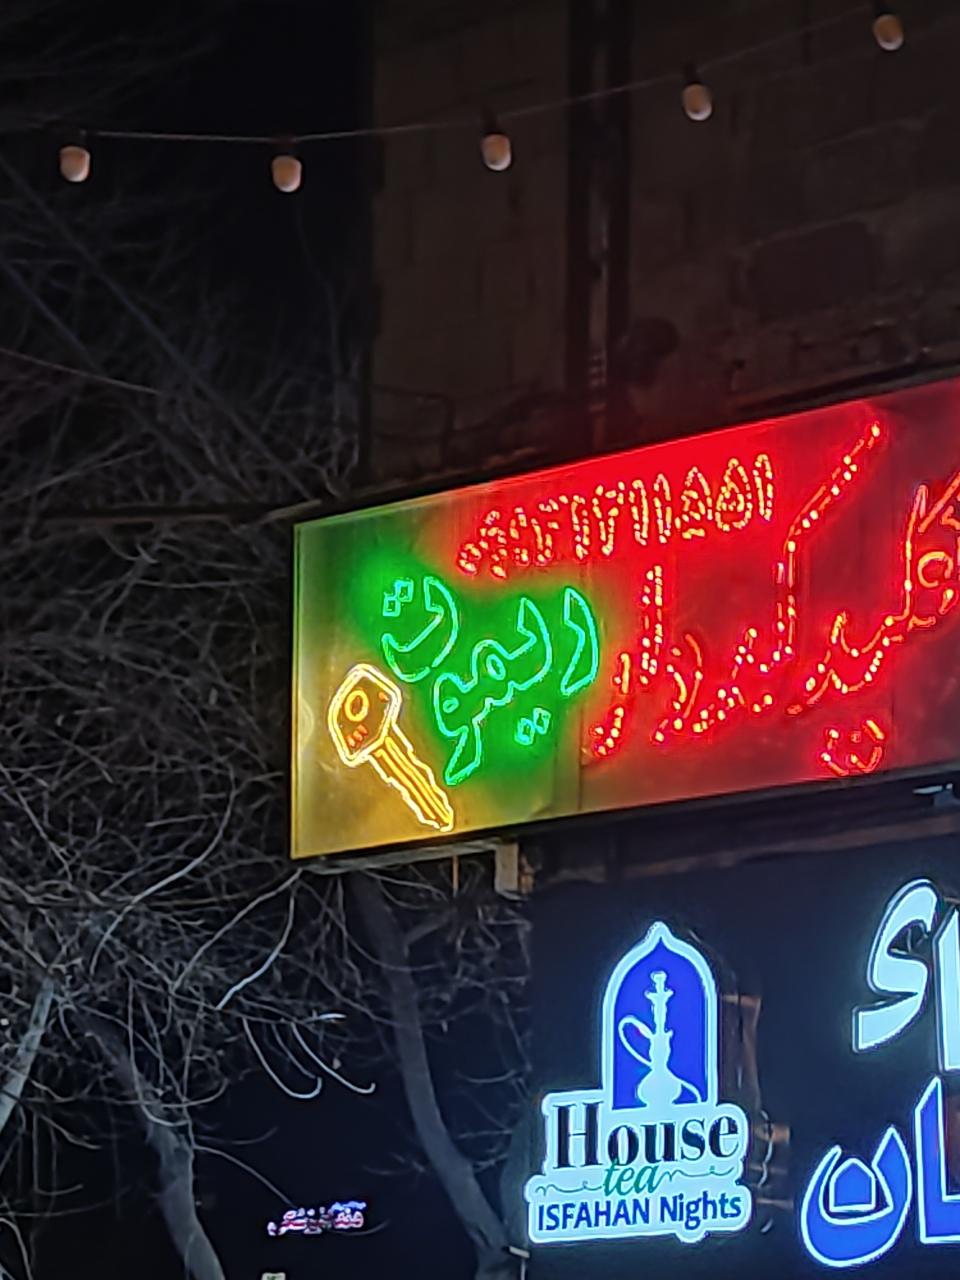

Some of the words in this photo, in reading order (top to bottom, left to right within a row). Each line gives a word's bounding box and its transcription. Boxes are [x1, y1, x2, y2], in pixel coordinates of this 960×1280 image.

[380, 575, 600, 786] ریموت
[553, 1101, 739, 1169] House
[602, 1158, 661, 1196] tea
[537, 1198, 651, 1231] ISFAHAN
[659, 1190, 742, 1231] Nights
